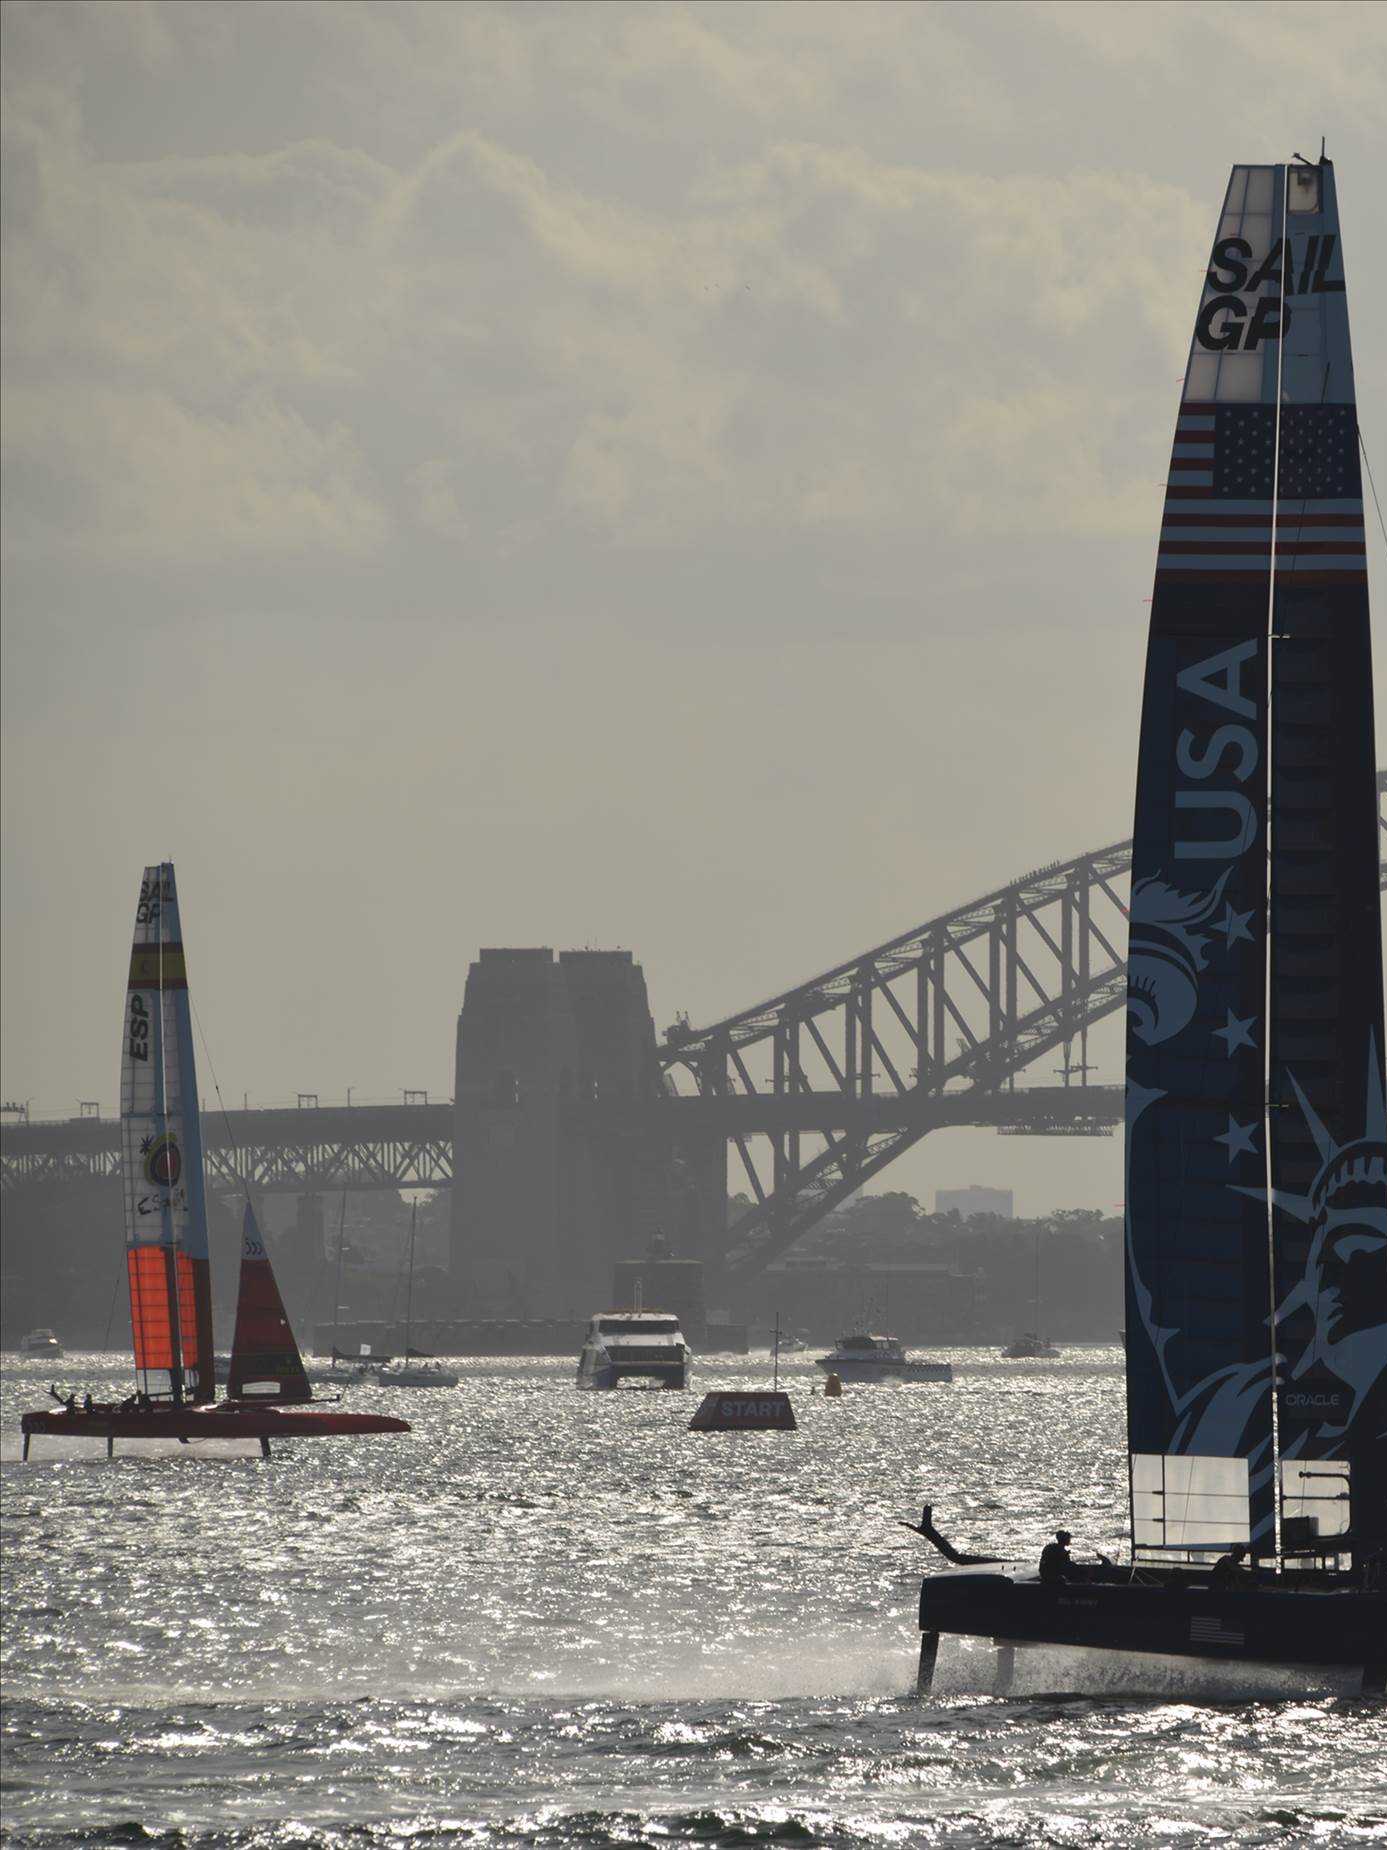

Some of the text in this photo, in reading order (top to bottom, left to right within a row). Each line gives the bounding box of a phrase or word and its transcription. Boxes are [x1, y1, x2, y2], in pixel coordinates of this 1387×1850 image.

[1206, 235, 1346, 295] SAIL
[1195, 295, 1292, 350] GP
[1174, 637, 1258, 859] USA
[140, 881, 174, 902] SAIL
[136, 902, 161, 924] GP
[130, 995, 148, 1061] ESP
[720, 1400, 785, 1417] START
[1285, 1394, 1340, 1406] ORACLE
